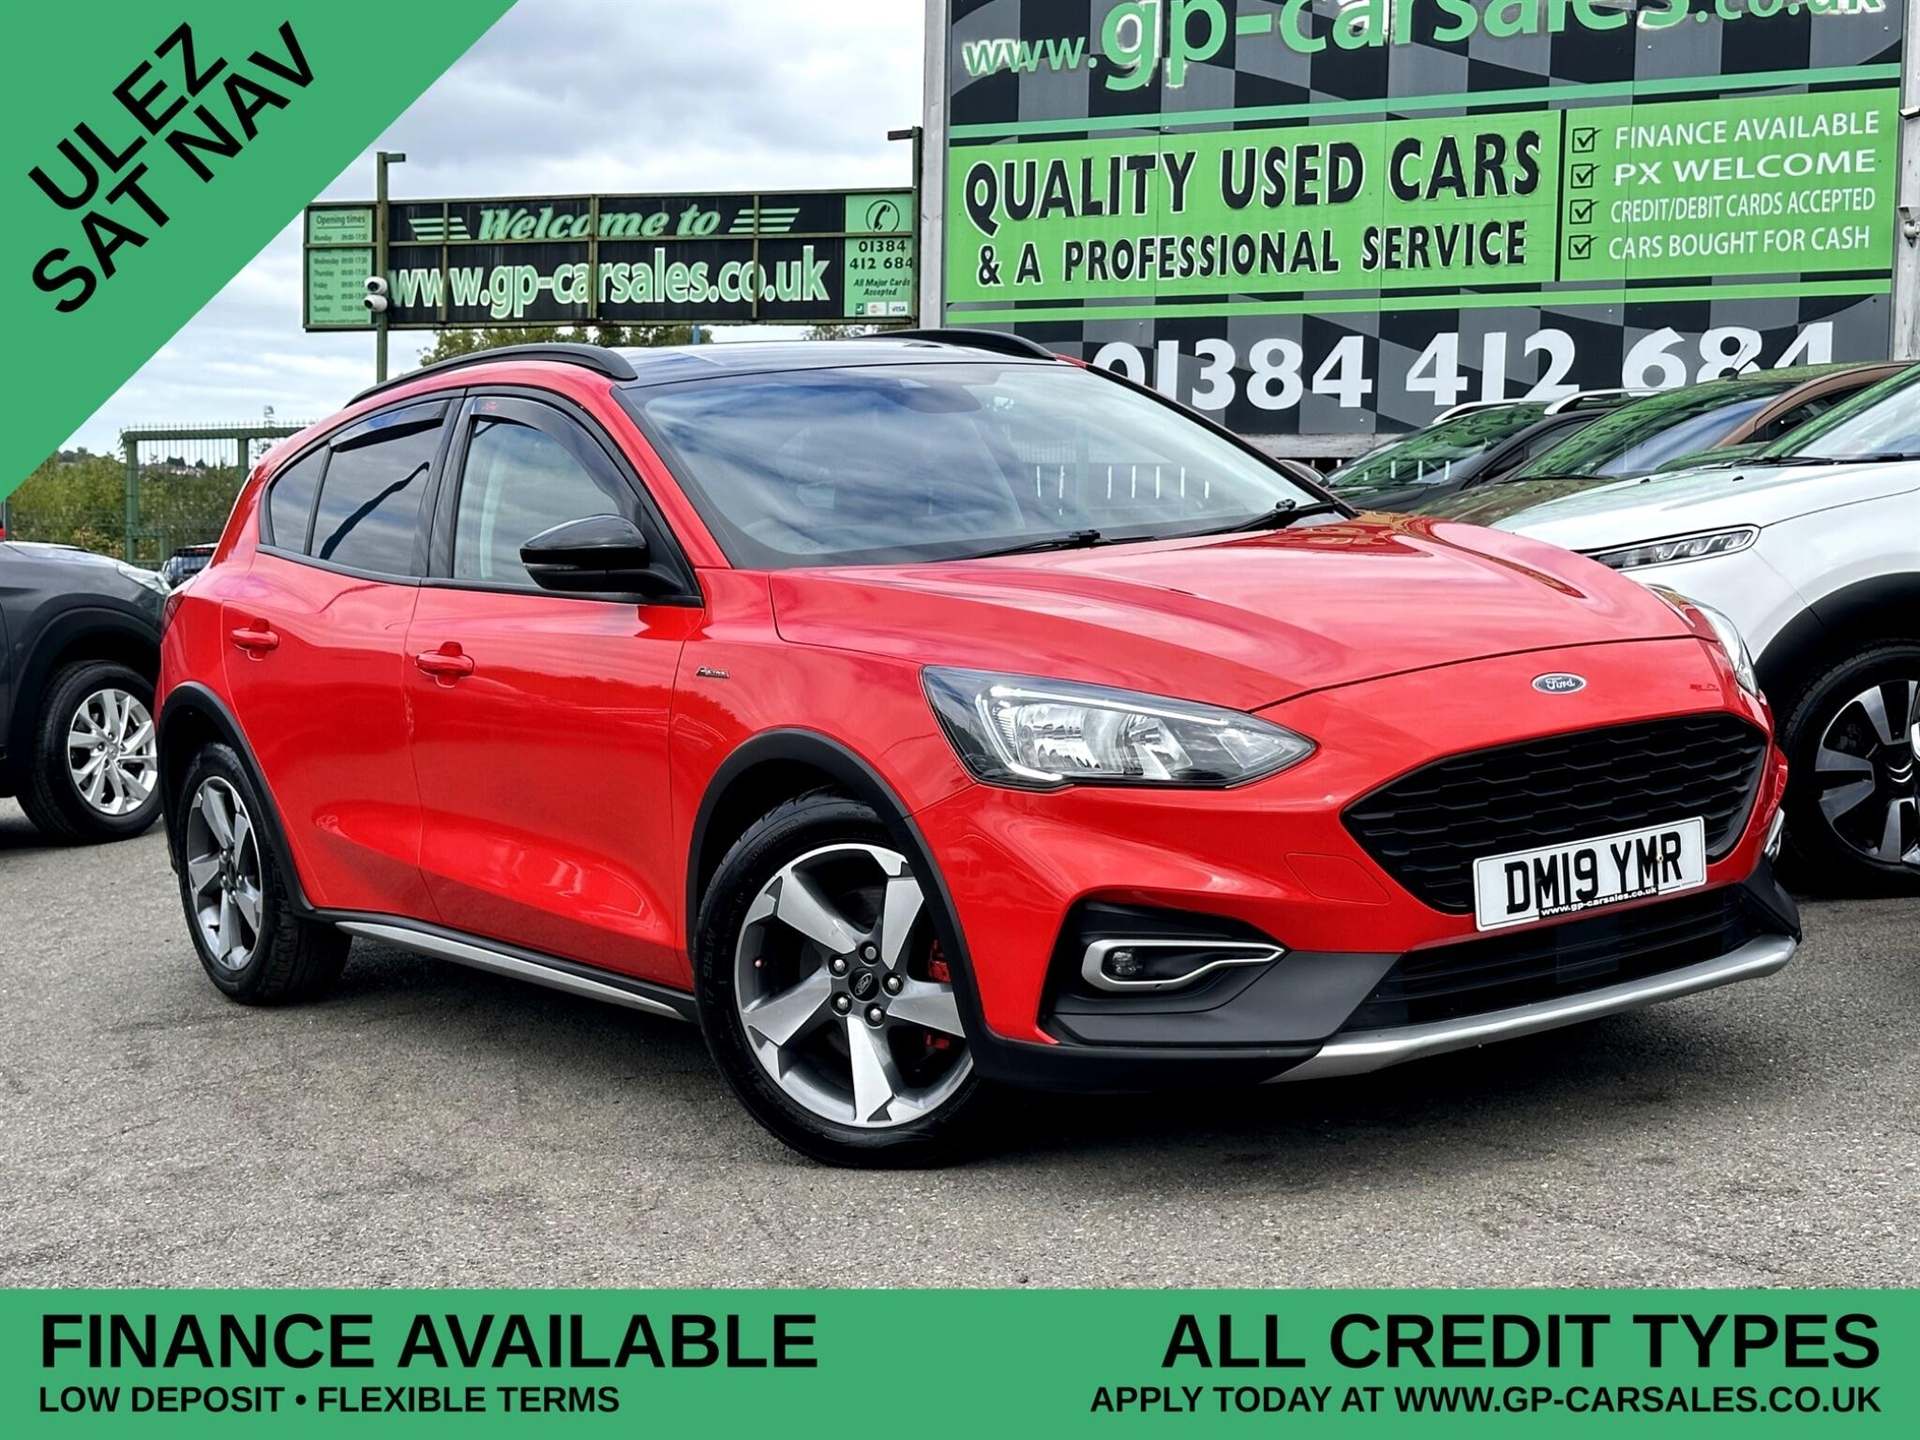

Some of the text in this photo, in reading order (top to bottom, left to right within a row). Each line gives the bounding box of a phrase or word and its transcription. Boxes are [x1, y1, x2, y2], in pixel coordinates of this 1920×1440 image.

[962, 0, 1886, 92] www.gp-carsa.co.
[1615, 110, 1880, 150] FINANCE AVAILABLE
[965, 130, 1541, 237] QUALITY USED CARS
[1614, 149, 1876, 186] PX WELCOME
[316, 214, 366, 226] Opening times
[478, 203, 721, 240] Welcome to
[1610, 187, 1876, 223] CREDIT/DEBIT CARDS ACCEPTED
[858, 239, 906, 252] 01384
[978, 219, 1526, 286] & A PROFESSIONAL SERVICE
[1608, 225, 1870, 260] CARS BOUGHT FOR CASH
[388, 244, 831, 319] www.gp-carsales.co.uk
[849, 257, 913, 269] 412 684
[853, 277, 910, 288] All Major Cards
[1405, 327, 1580, 406] 412
[1545, 677, 1576, 690] Ford
[1610, 831, 1682, 892] YMR
